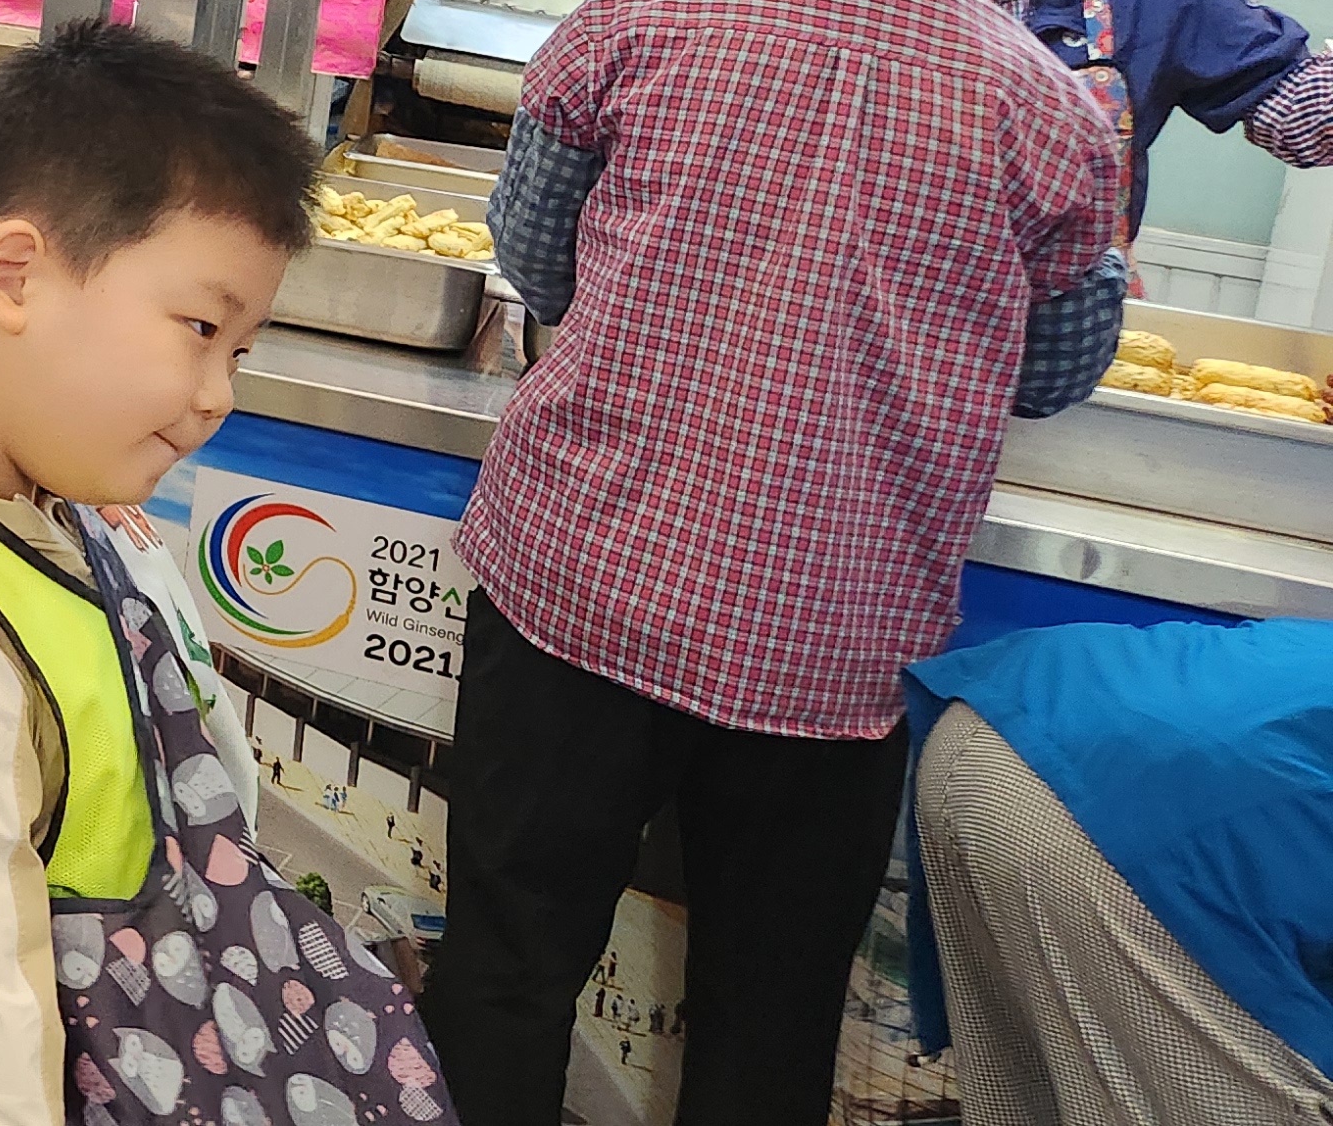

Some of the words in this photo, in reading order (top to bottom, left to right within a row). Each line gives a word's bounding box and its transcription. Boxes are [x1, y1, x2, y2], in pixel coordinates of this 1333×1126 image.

[370, 535, 440, 573] 2021
[366, 608, 399, 628] Wild
[402, 617, 465, 646] Ginseng
